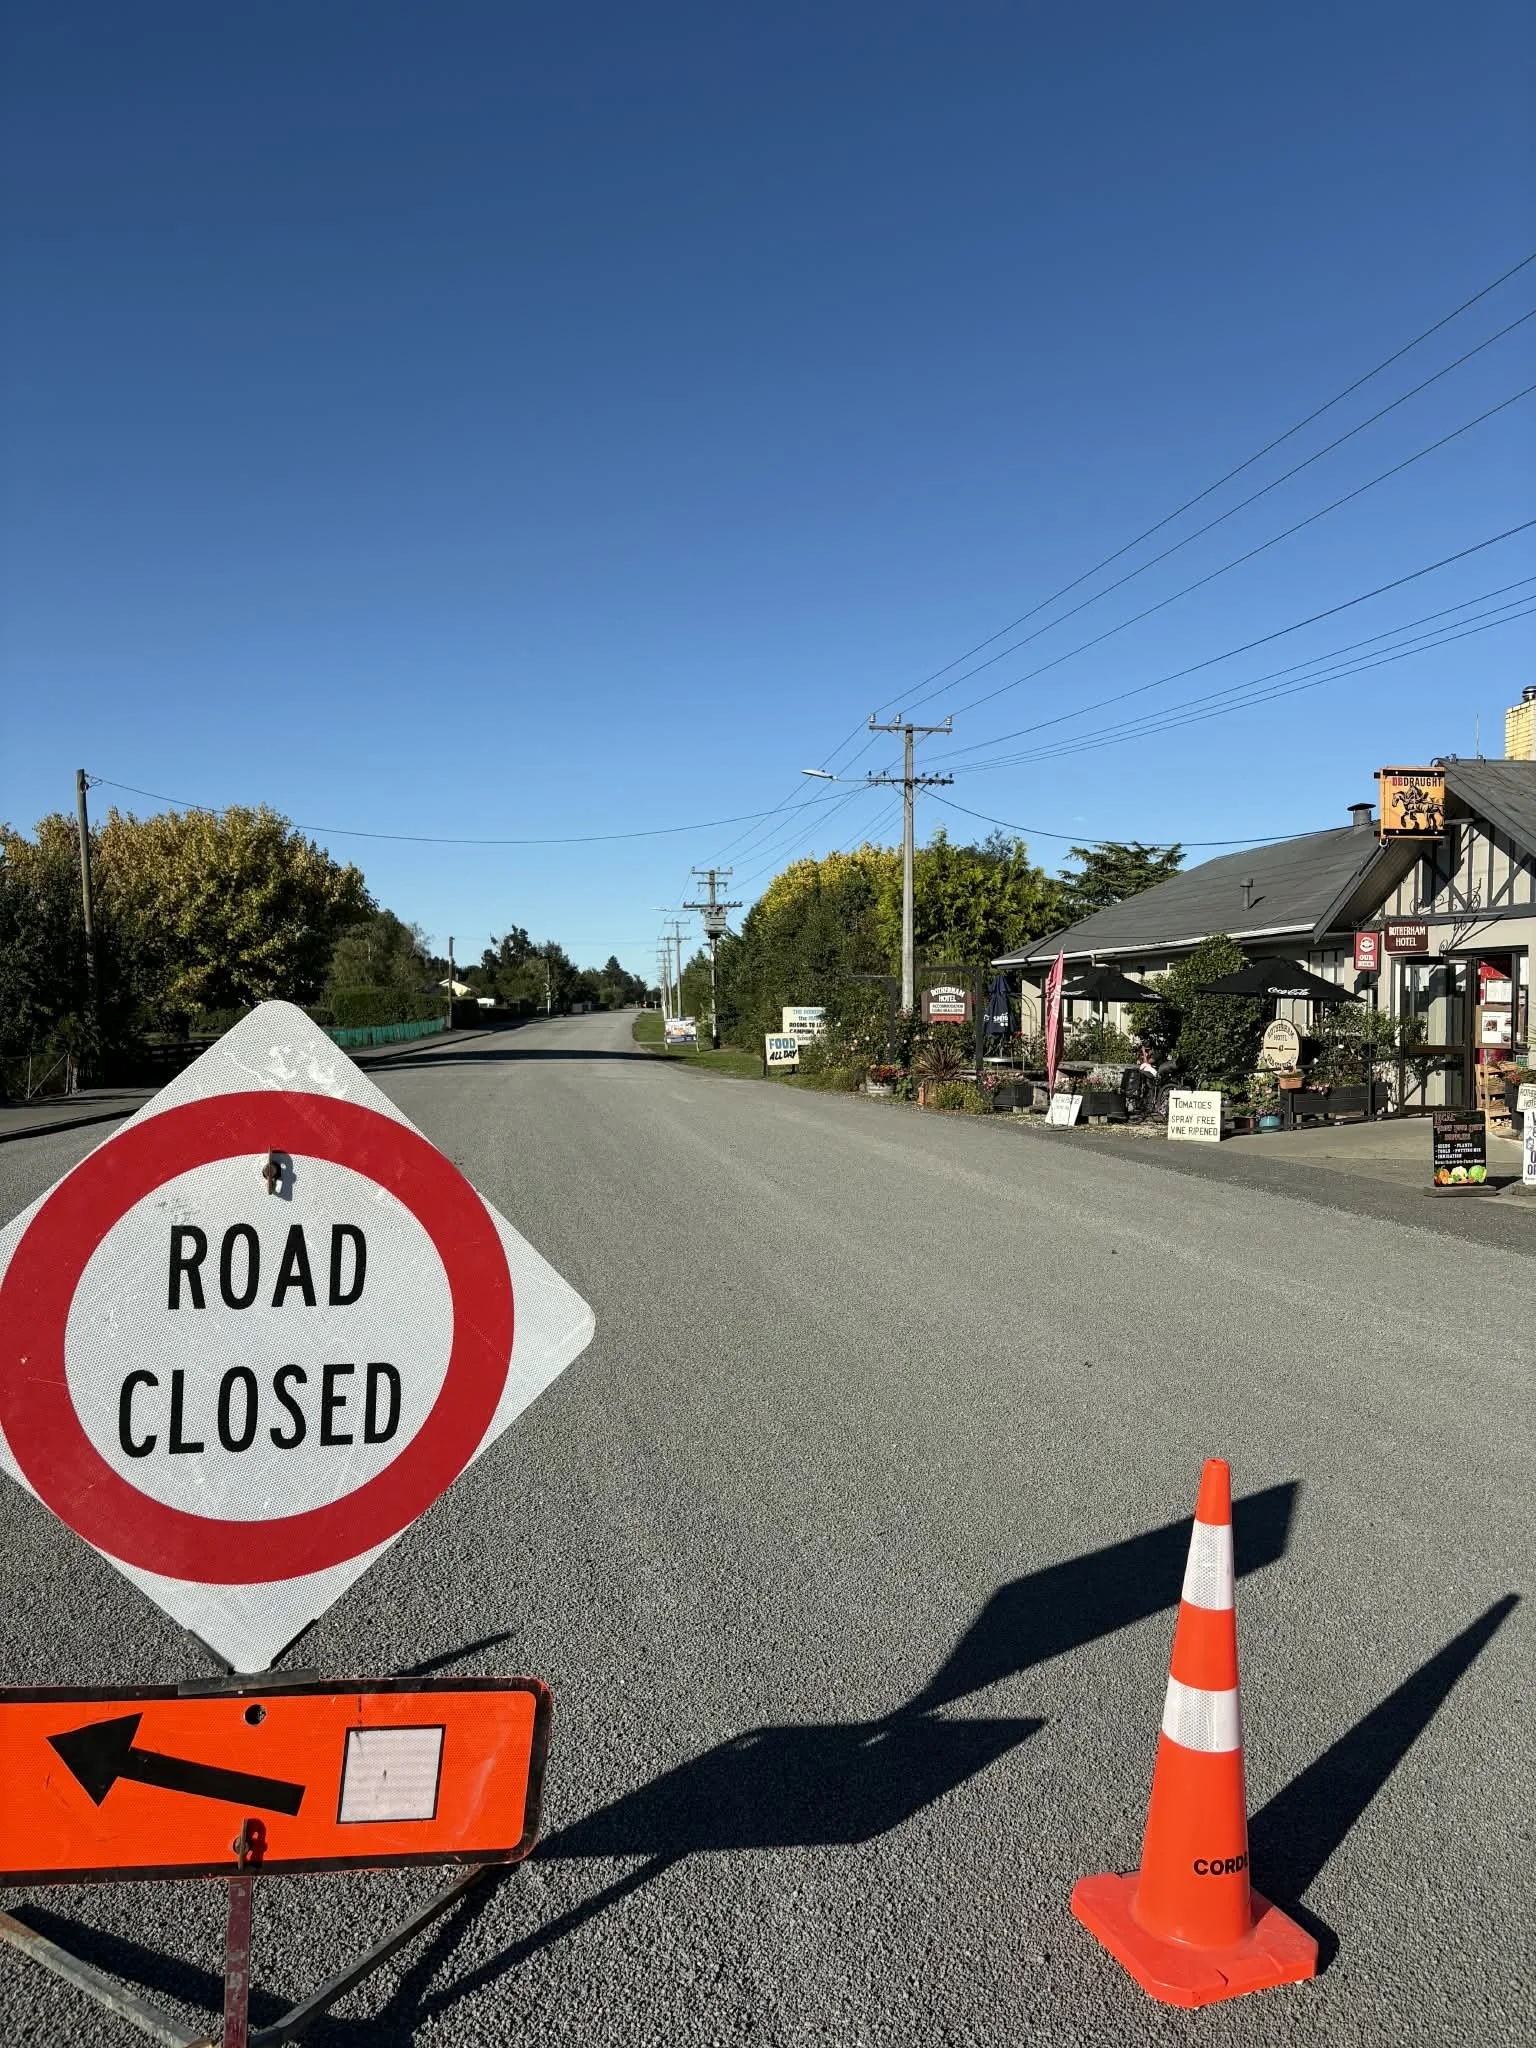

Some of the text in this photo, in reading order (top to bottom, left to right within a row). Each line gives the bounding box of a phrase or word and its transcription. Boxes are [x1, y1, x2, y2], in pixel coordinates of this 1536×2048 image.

[1388, 926, 1426, 936] ROTHERHAM
[1395, 937, 1417, 947] HOTEL
[938, 994, 957, 1002] HOTEL
[769, 1037, 796, 1049] FOOD
[770, 1049, 798, 1061] ALL DAY
[1171, 1097, 1213, 1109] TOMATOES
[1171, 1115, 1217, 1125] SPRAY FREE
[1170, 1126, 1218, 1136] VINE RIPENED
[168, 1223, 367, 1310] ROAD
[119, 1362, 402, 1458] CLOSED
